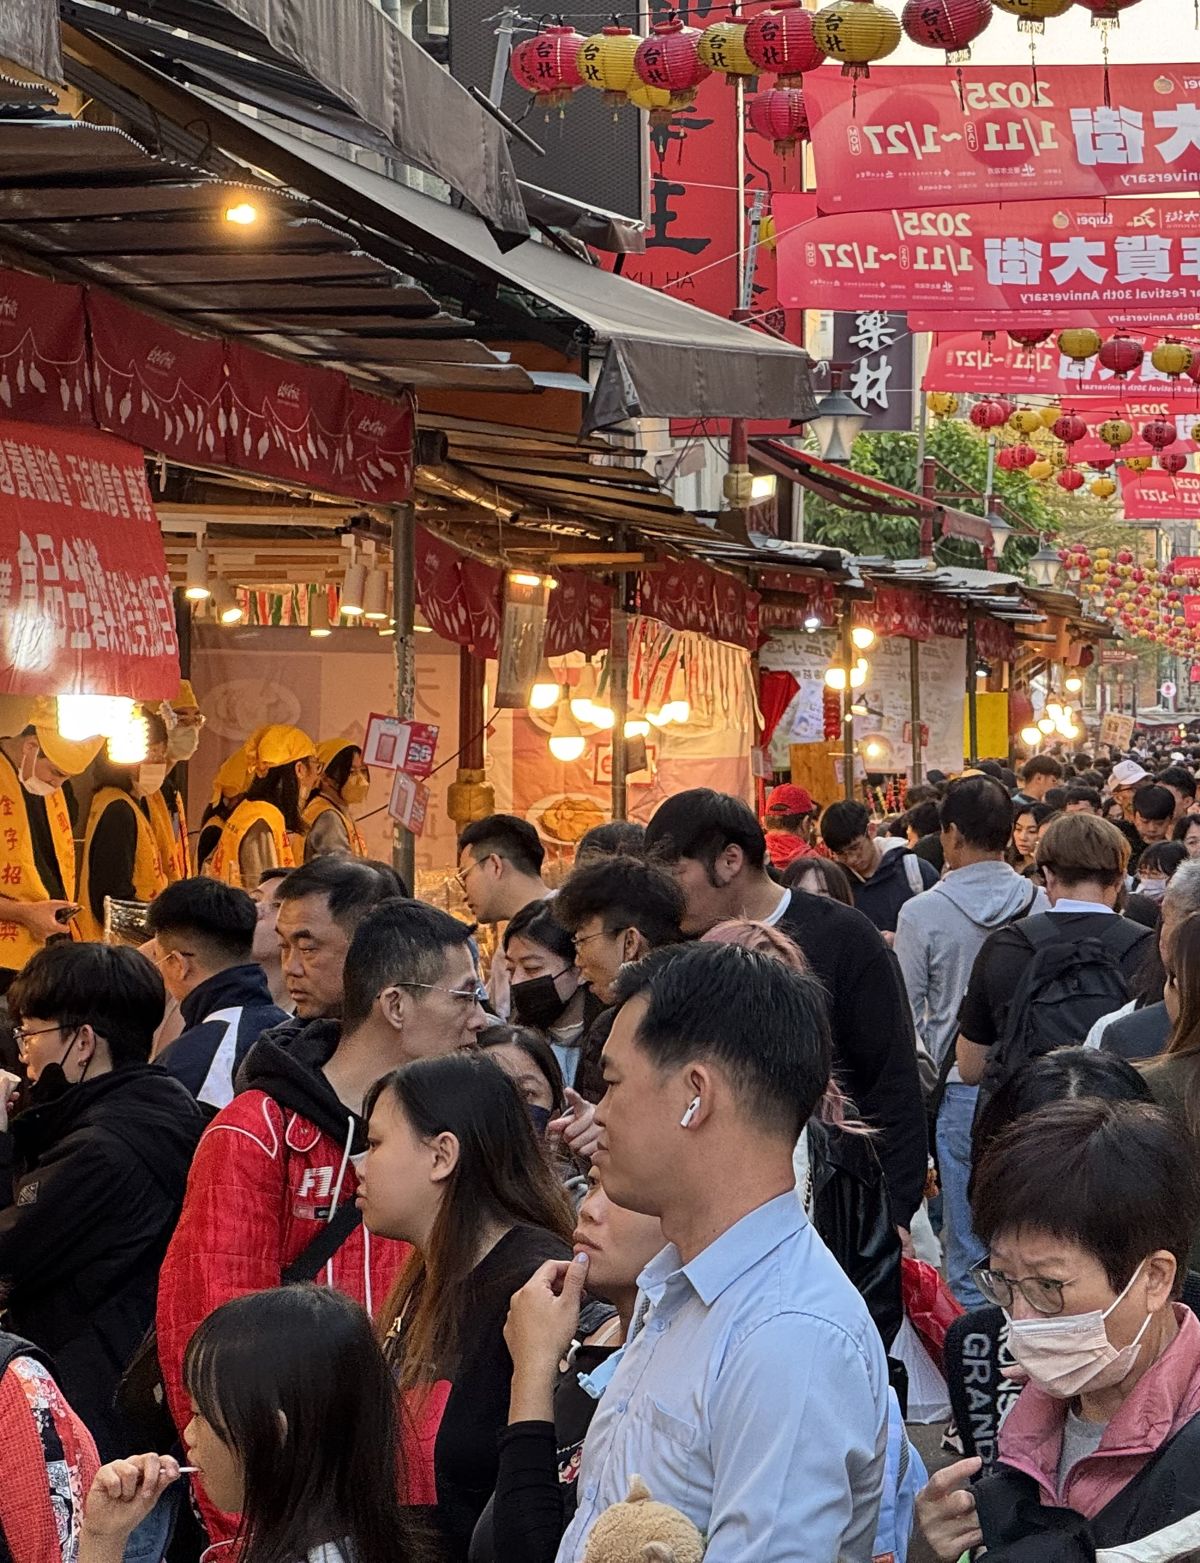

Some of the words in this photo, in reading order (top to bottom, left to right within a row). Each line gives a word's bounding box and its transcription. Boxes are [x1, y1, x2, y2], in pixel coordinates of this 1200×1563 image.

[761, 22, 783, 65] 台北
[825, 13, 847, 52] 台北
[921, 9, 944, 42] 台北
[536, 42, 556, 79] 台北
[584, 43, 602, 81] 台北
[644, 48, 668, 83] 台北
[710, 34, 728, 67] 台北
